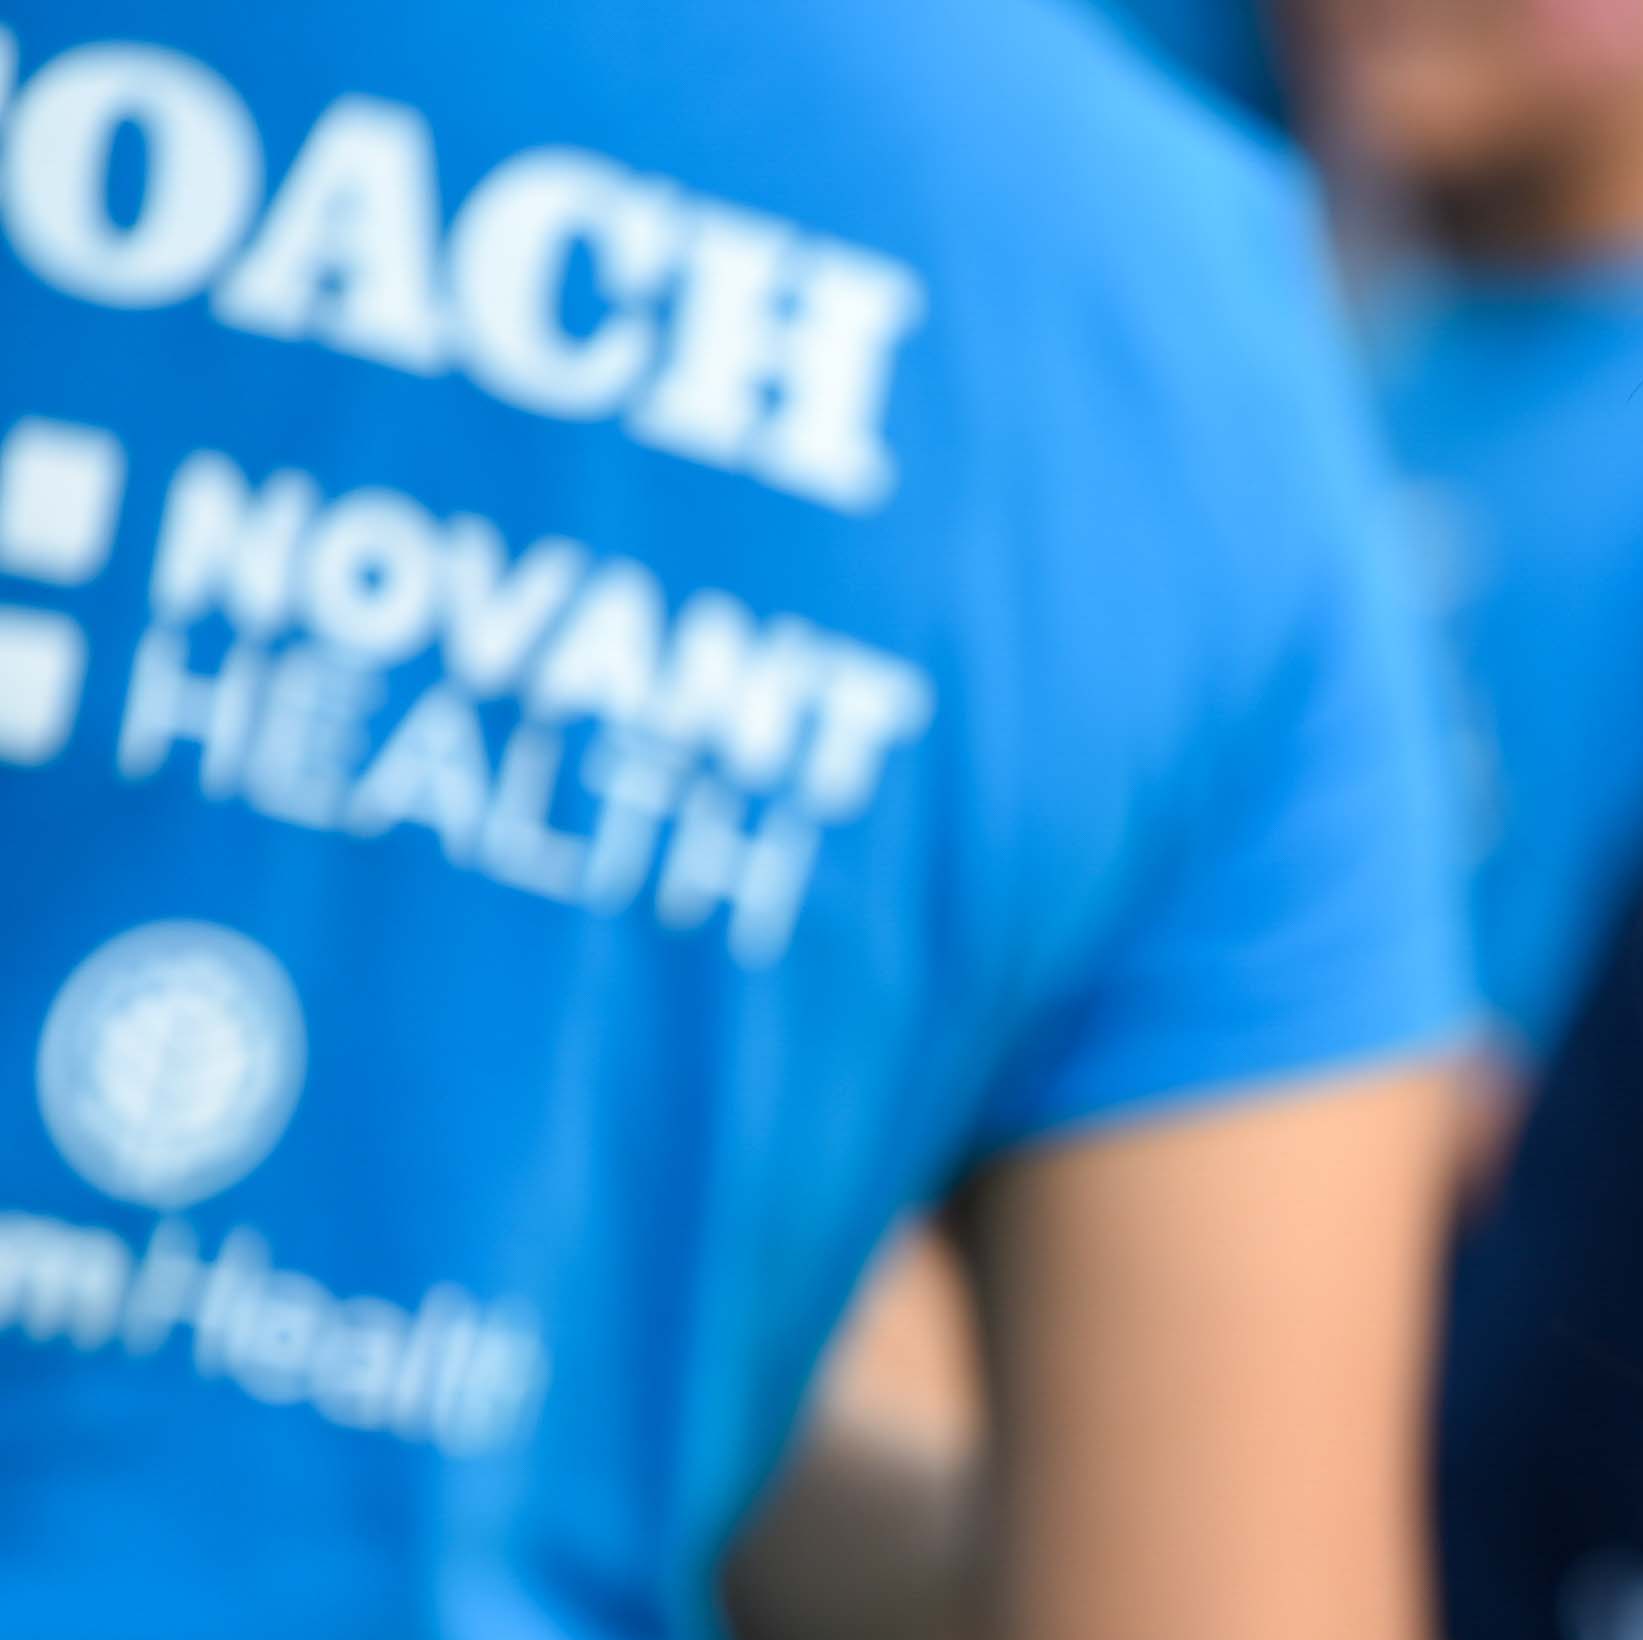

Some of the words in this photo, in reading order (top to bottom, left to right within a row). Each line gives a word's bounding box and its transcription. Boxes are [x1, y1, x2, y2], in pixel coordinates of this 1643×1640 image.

[0, 22, 926, 516] OACH
[118, 622, 820, 970] HEALTH
[152, 450, 934, 822] NOVANT
